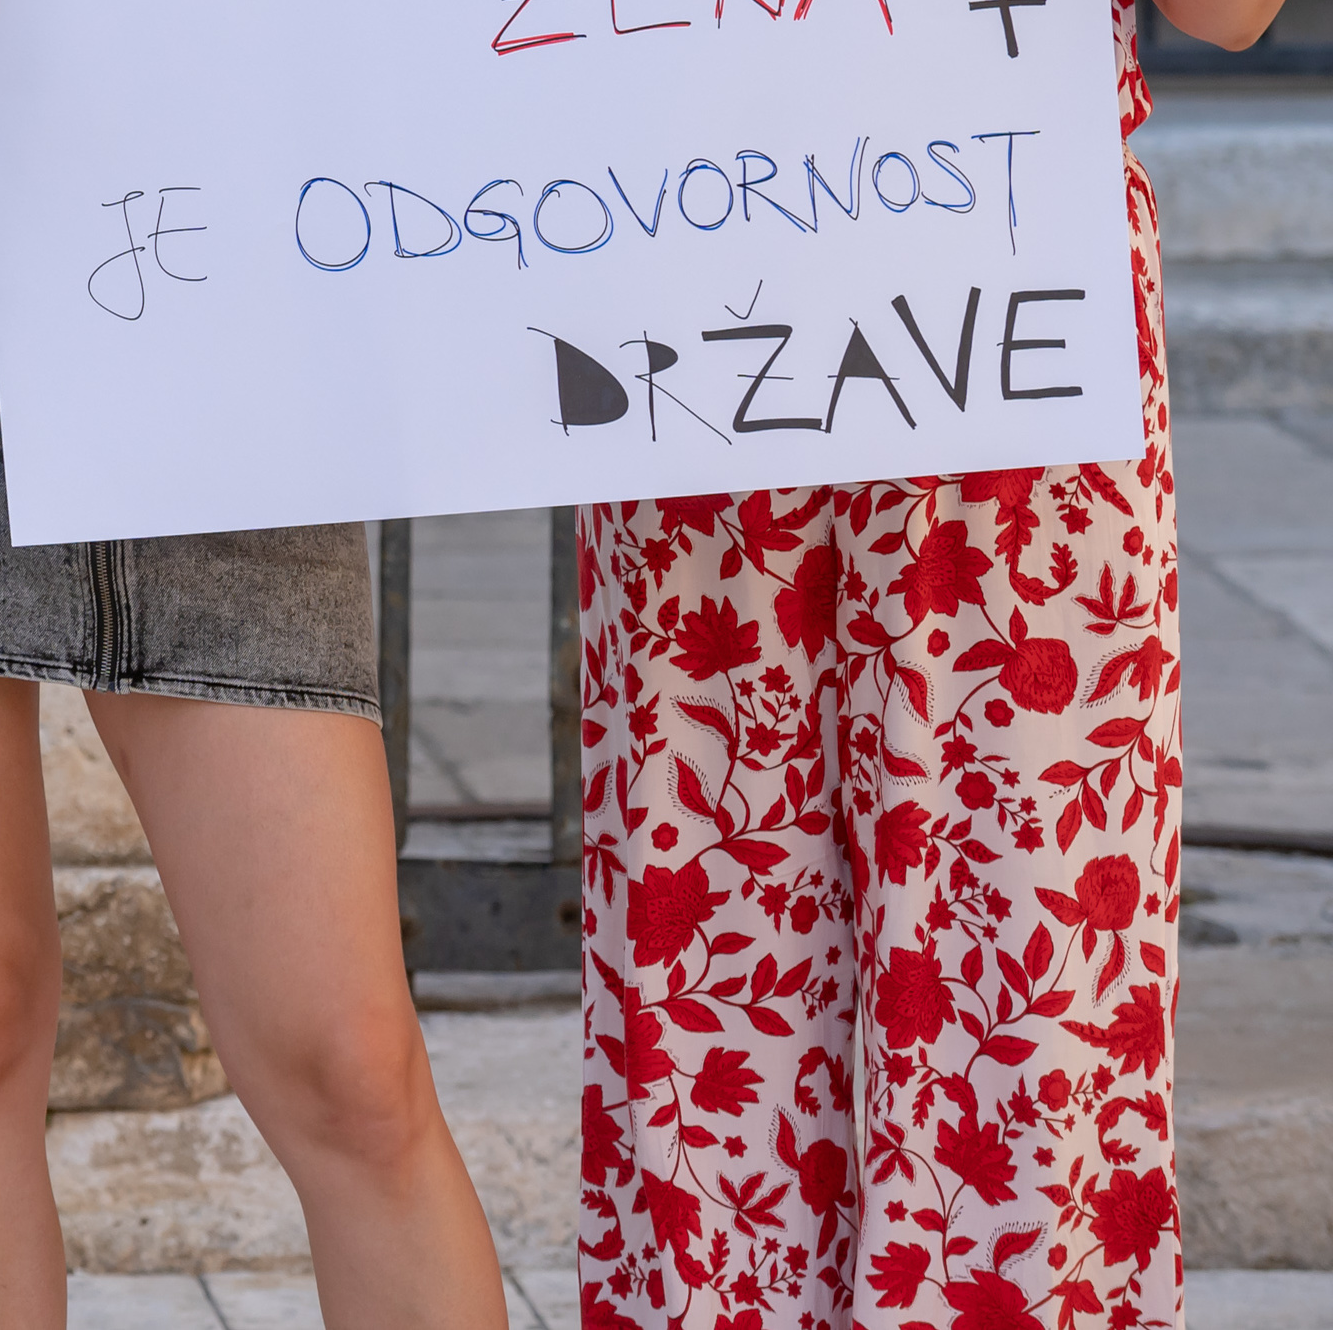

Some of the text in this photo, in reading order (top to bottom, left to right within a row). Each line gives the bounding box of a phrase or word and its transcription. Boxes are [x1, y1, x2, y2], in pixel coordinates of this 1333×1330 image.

[87, 130, 1041, 321] JE ODGOVORNOST
[526, 279, 1086, 446] DRŽAVE
